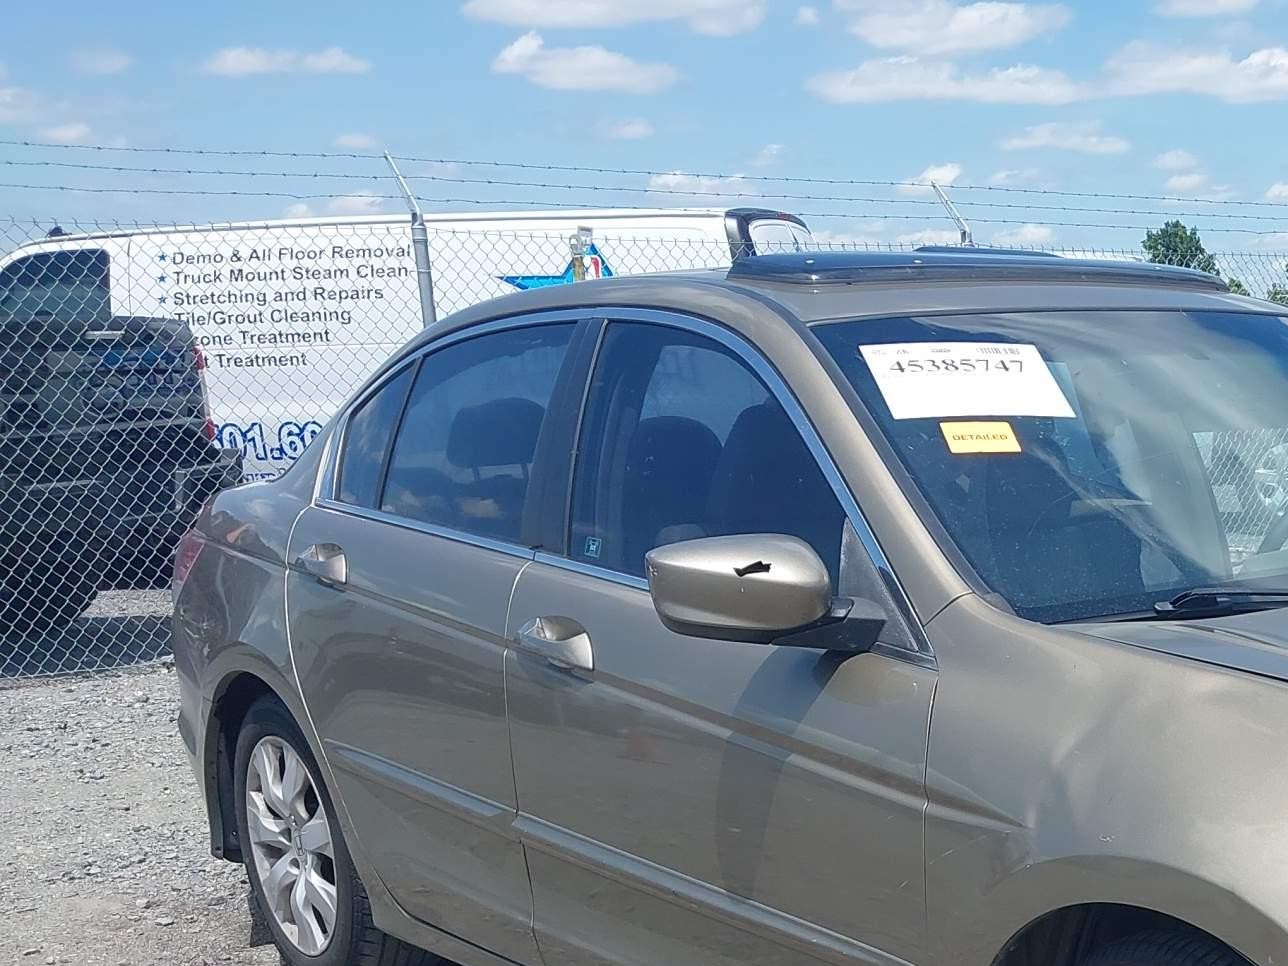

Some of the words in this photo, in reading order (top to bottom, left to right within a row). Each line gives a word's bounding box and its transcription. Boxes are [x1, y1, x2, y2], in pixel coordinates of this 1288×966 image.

[172, 251, 224, 265] Demo
[230, 249, 242, 263] &
[248, 248, 271, 262] All
[278, 246, 325, 261] Floor
[331, 244, 411, 259] Removal
[173, 270, 223, 285] Truck
[229, 268, 286, 282] Mount
[292, 266, 349, 280] Steam
[173, 290, 267, 307] Stretching
[273, 287, 306, 302] and
[313, 286, 384, 303] Repairs
[174, 310, 265, 326] Tile/Grout
[270, 308, 351, 325] Cleaning
[238, 329, 331, 346] Treatment
[215, 352, 308, 369] Treatment
[889, 358, 1024, 373] 45385747
[952, 433, 1008, 442] DETAILED
